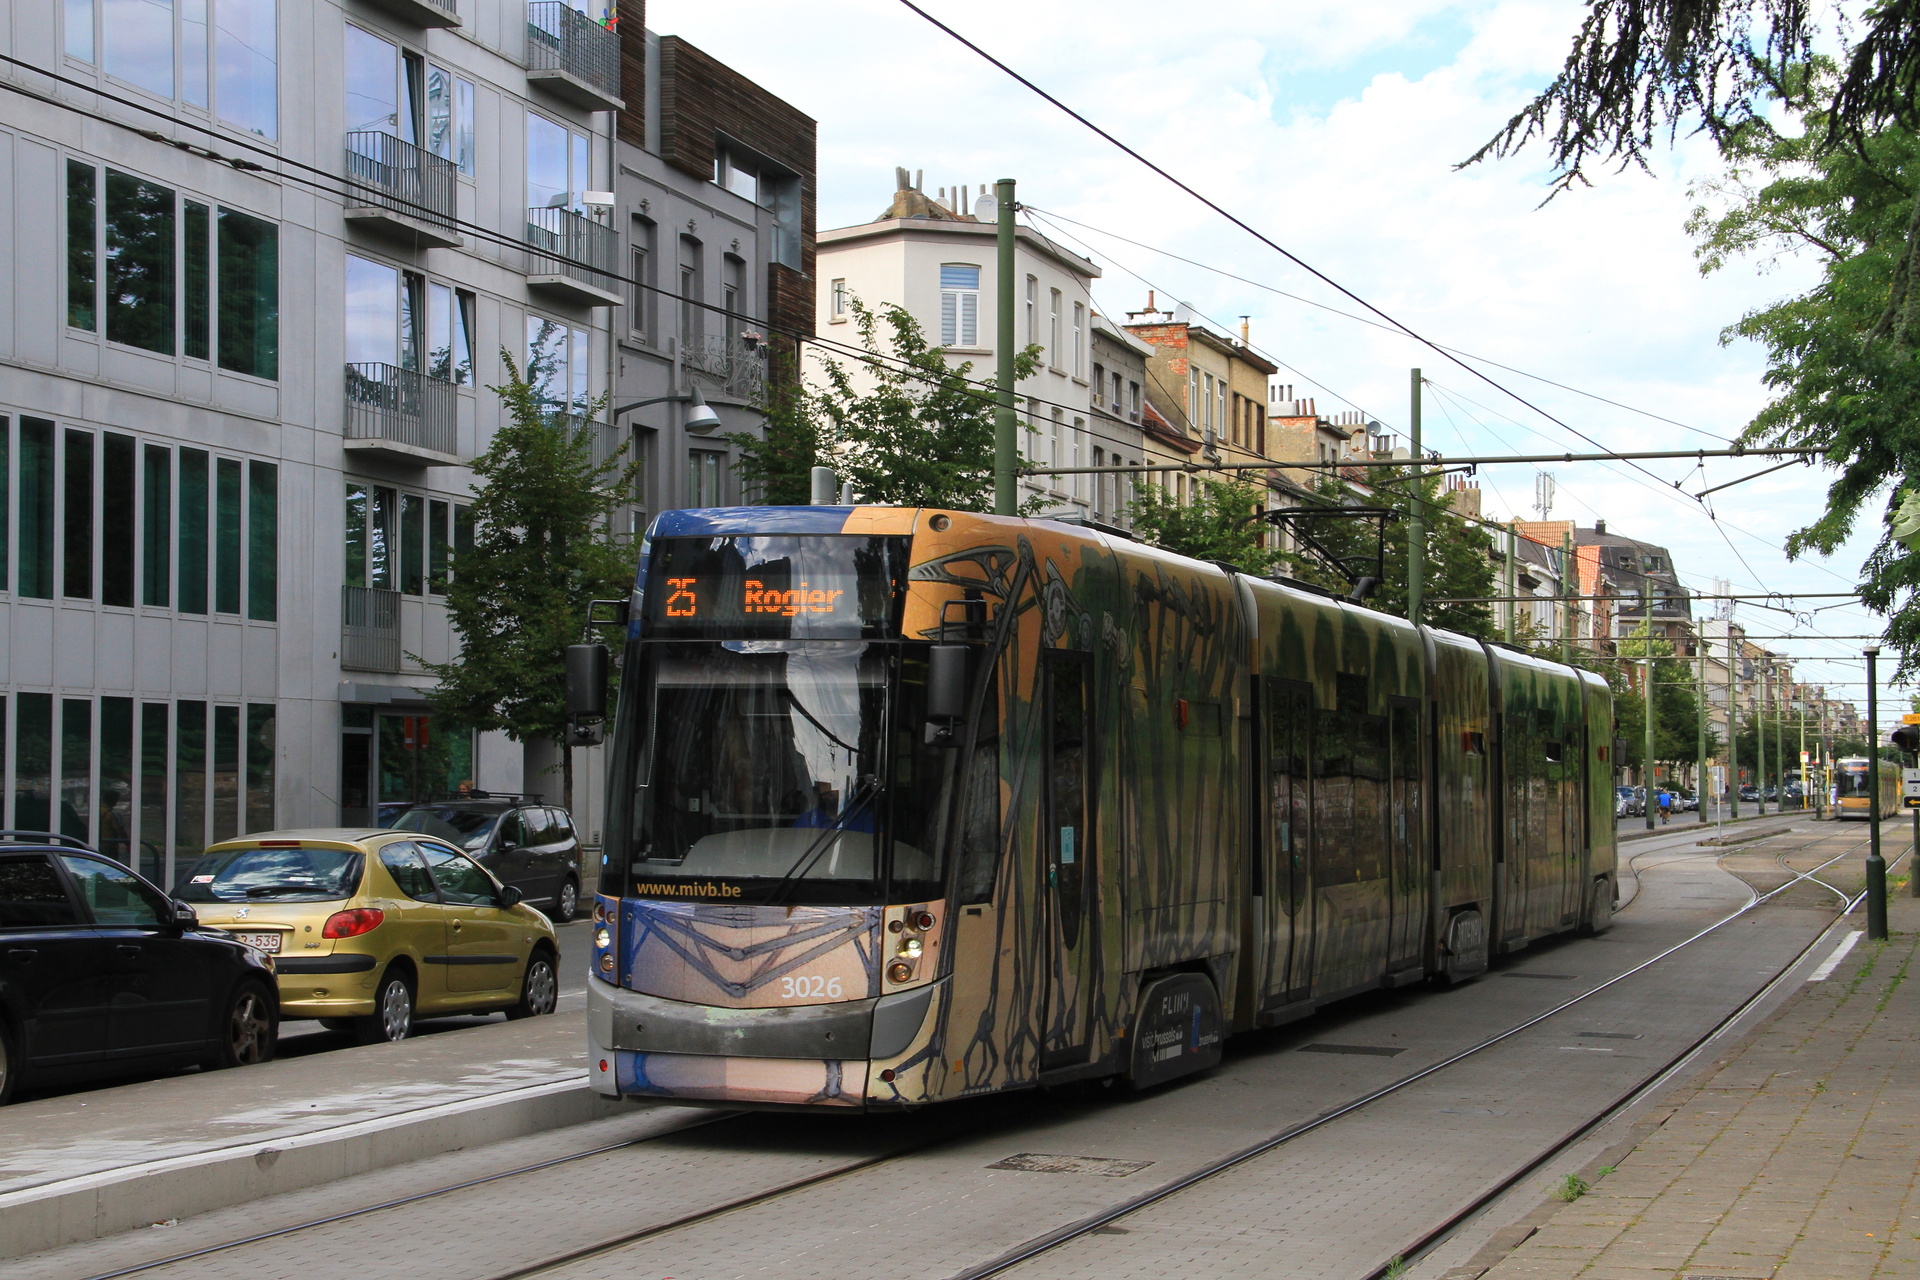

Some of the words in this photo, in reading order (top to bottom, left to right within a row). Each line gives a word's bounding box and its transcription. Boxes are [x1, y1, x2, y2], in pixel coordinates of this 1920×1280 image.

[666, 578, 697, 617] 25
[745, 580, 843, 617] Rogier
[636, 881, 742, 898] www.mivb.be
[781, 976, 842, 998] 3026
